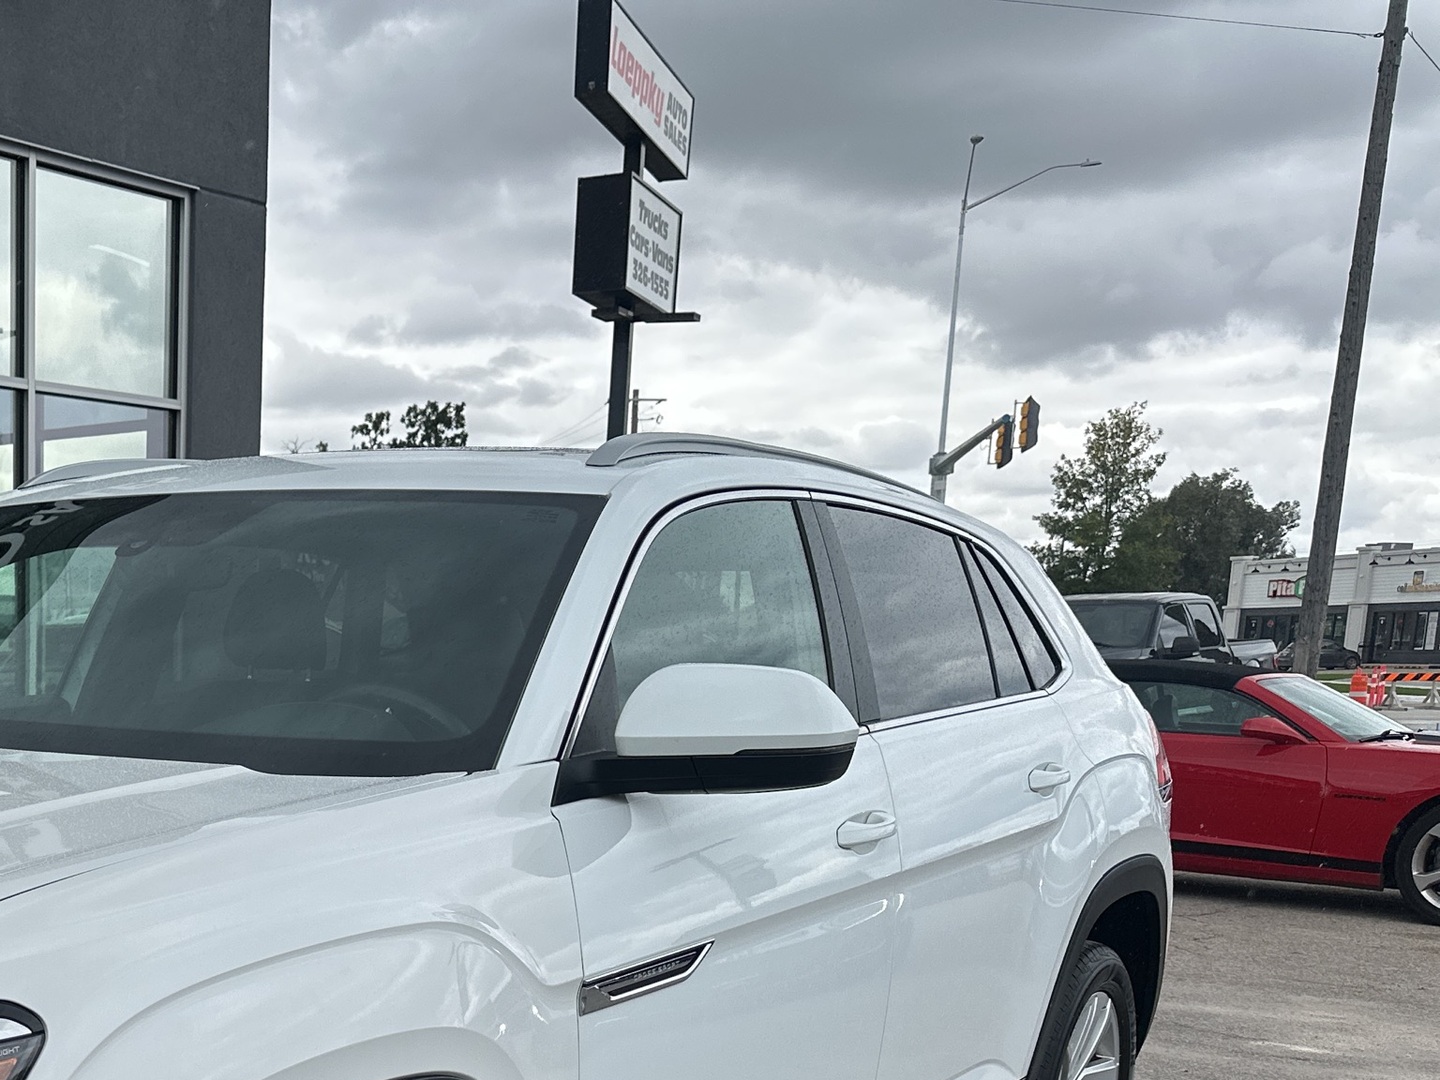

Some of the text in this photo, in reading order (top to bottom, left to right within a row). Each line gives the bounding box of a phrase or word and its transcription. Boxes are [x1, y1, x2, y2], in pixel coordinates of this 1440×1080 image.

[611, 25, 665, 128] Loeppky
[667, 91, 688, 130] AUTO
[664, 114, 688, 156] SALES
[639, 198, 669, 241] Trucks
[632, 258, 669, 301] 326-1555
[1269, 580, 1296, 596] Pita
